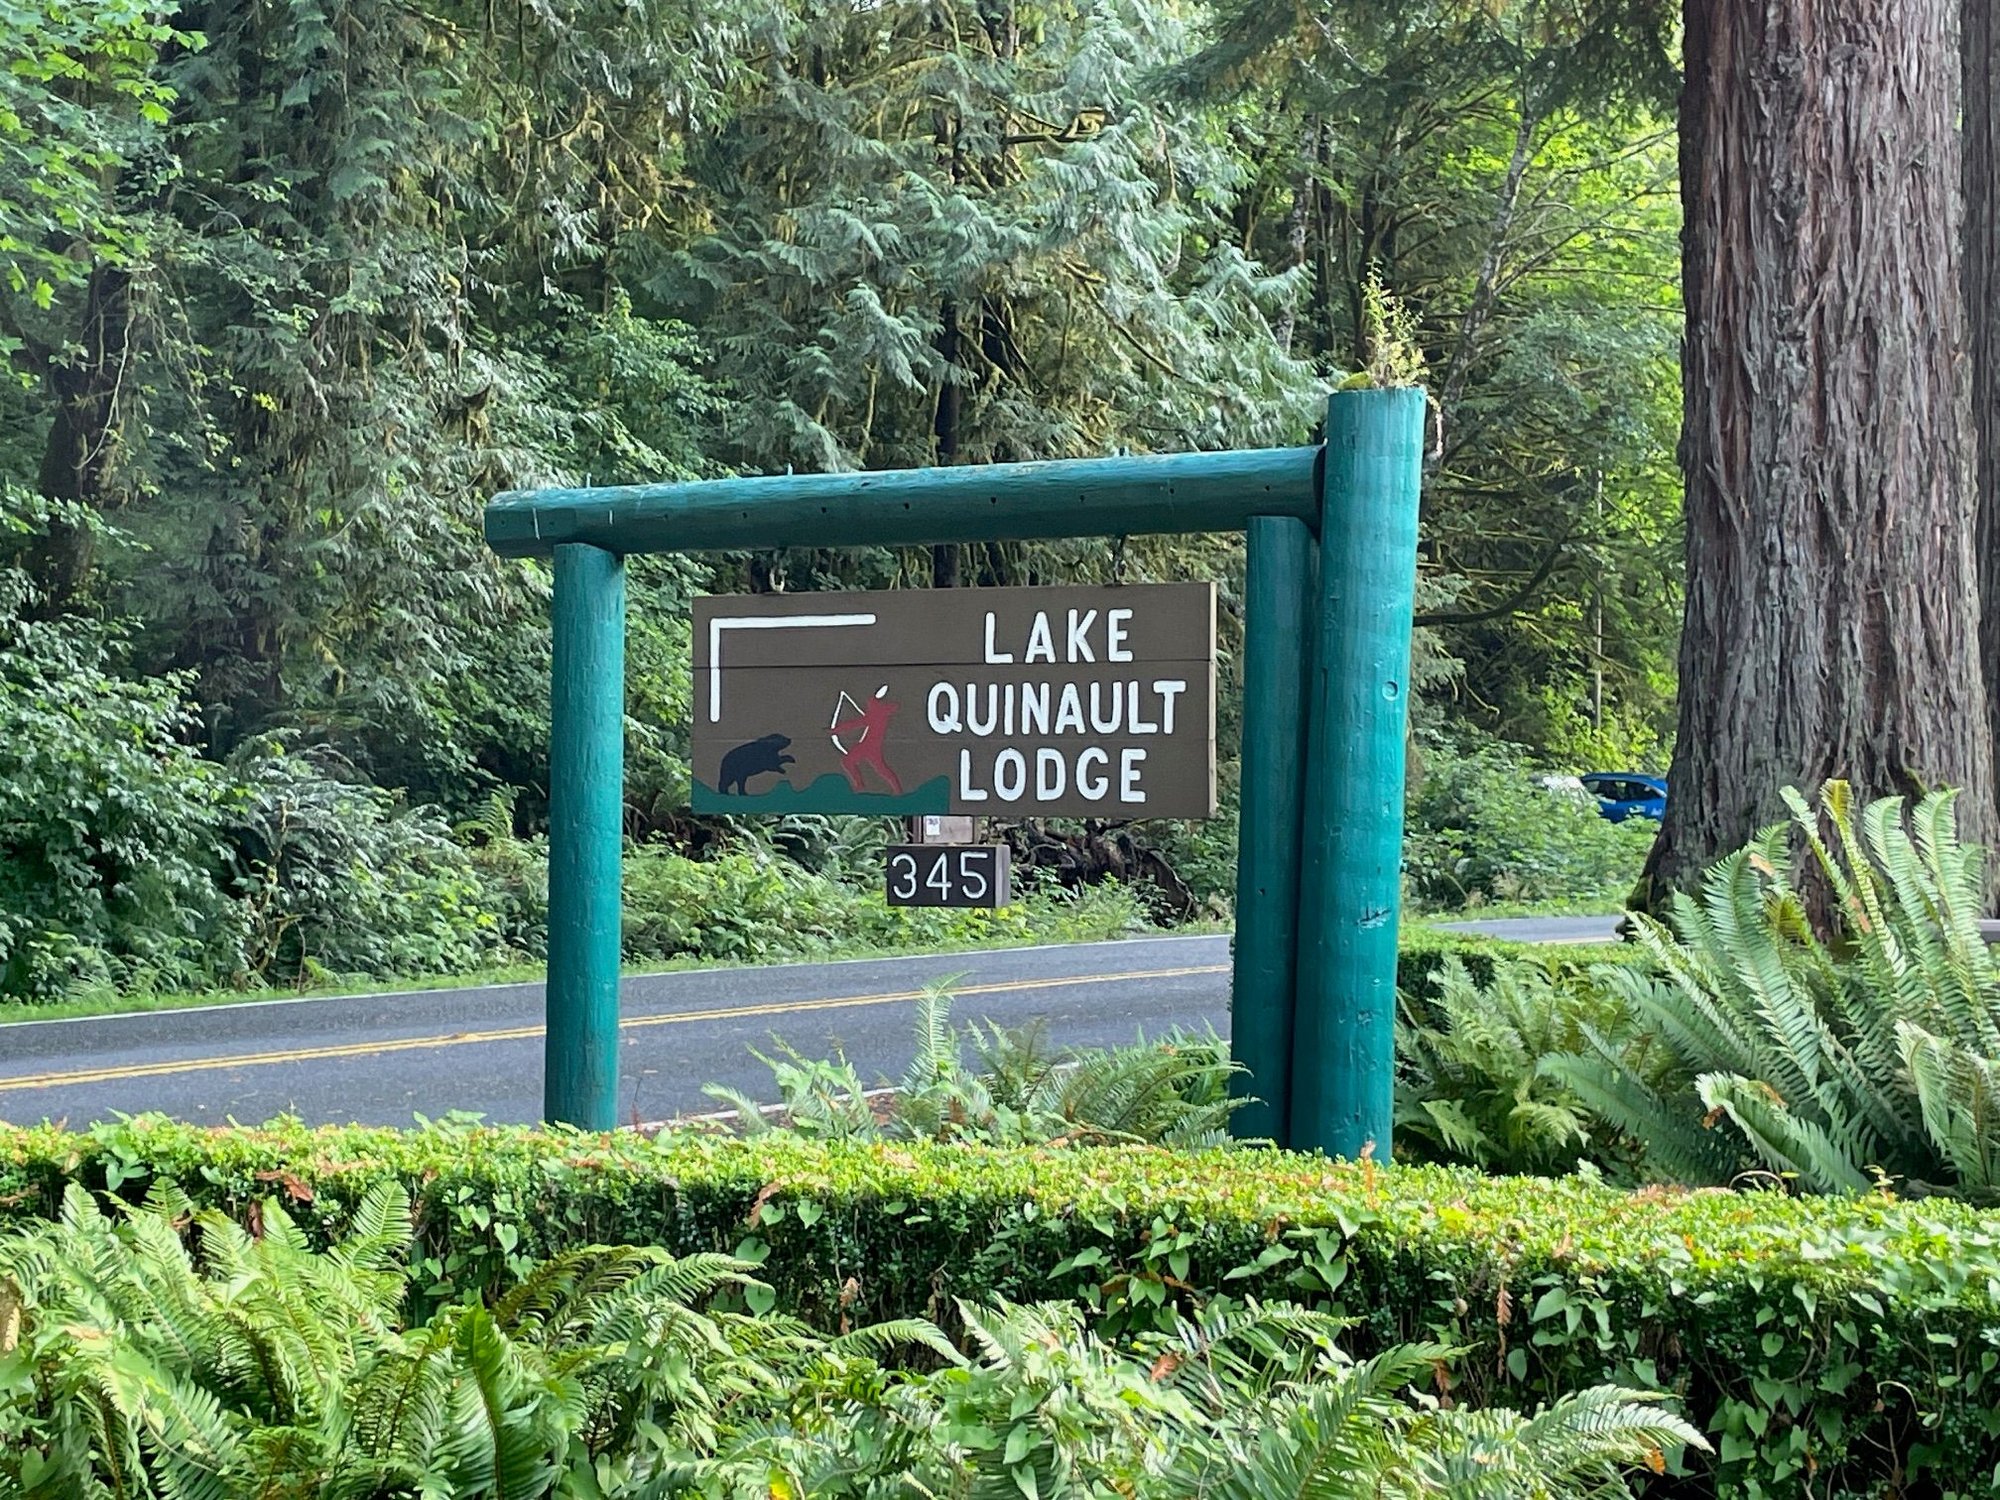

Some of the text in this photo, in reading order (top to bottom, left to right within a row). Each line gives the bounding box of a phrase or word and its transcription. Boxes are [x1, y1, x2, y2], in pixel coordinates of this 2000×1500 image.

[985, 608, 1133, 664] LAKE
[927, 680, 1186, 736] QUINAULT
[960, 748, 1147, 803] LODGE
[891, 851, 988, 901] 345
